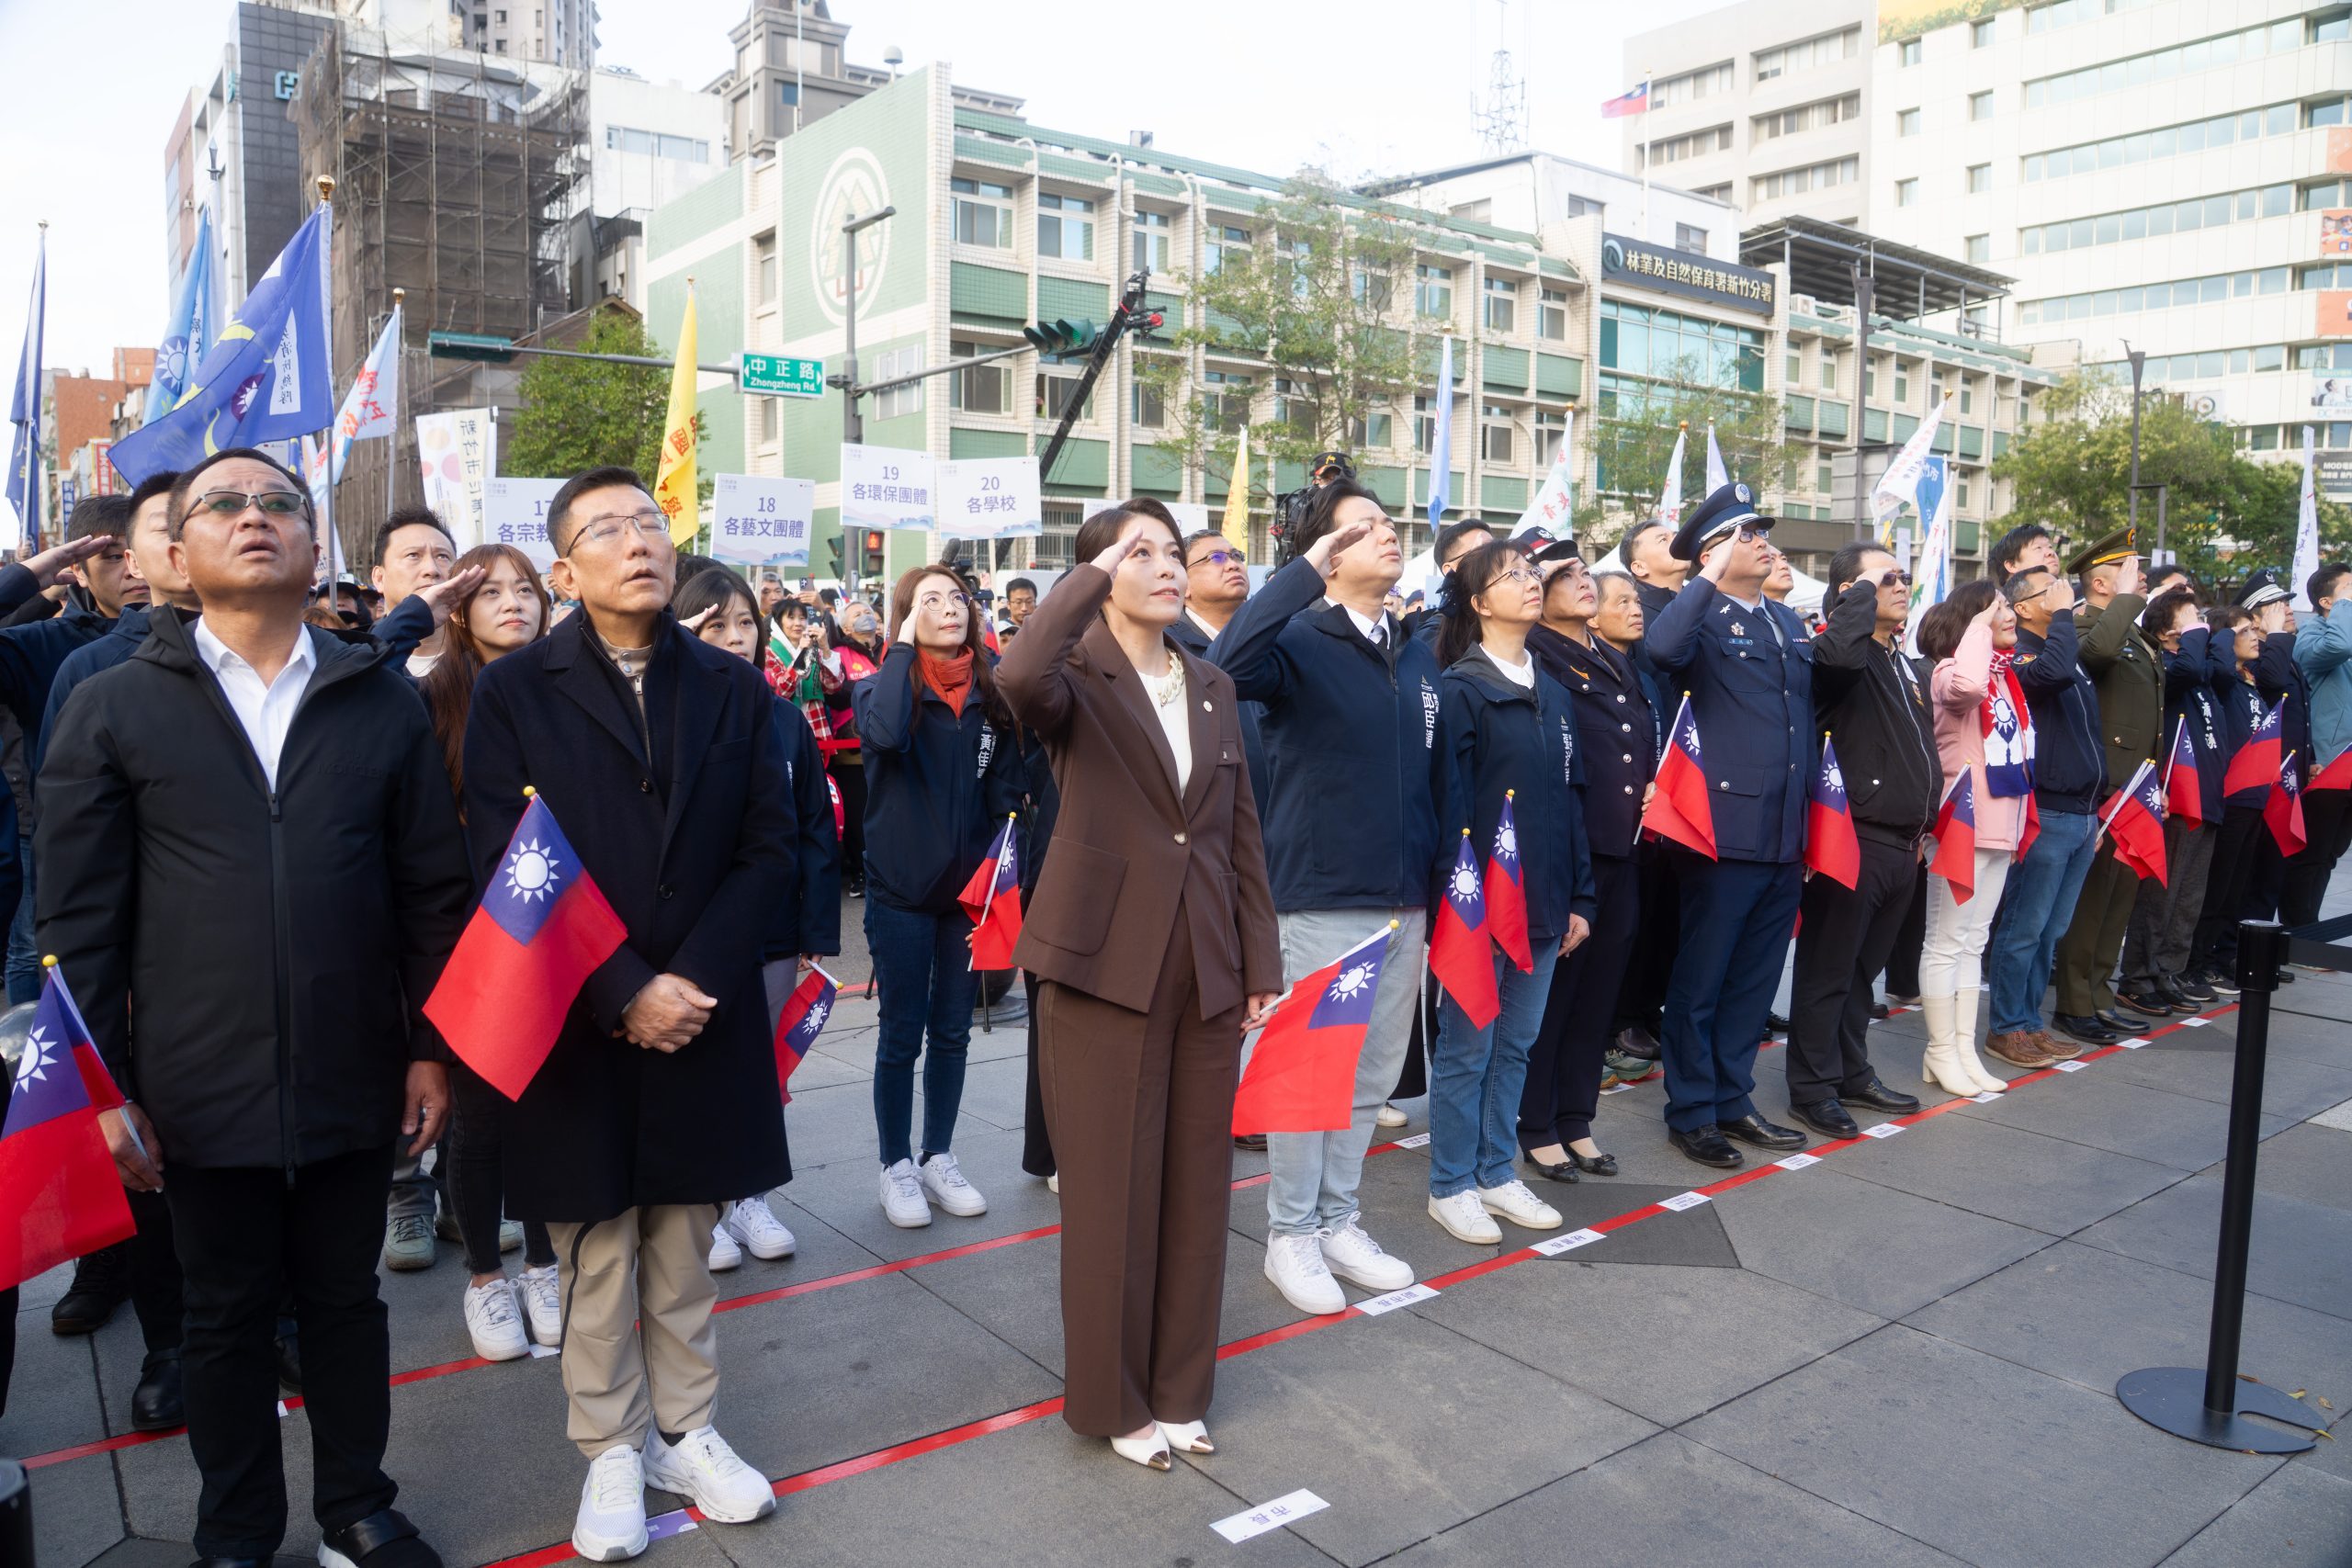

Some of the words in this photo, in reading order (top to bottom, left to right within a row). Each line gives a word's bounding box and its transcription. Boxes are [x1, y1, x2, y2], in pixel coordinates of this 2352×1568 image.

[1626, 250, 1772, 303] 林業及自然保育署新竹分署
[751, 357, 815, 380] 中正路
[750, 376, 801, 392] Zhongzheng
[803, 381, 817, 391] Rd.
[882, 466, 899, 480] 19
[980, 476, 1001, 491] 20
[853, 482, 928, 505] 各環保團體
[758, 497, 775, 513] 18
[967, 494, 1016, 513] 各學校
[724, 516, 805, 538] 各藝文團體
[1374, 1291, 1419, 1307] 副市長
[1248, 1506, 1292, 1526] 市長
